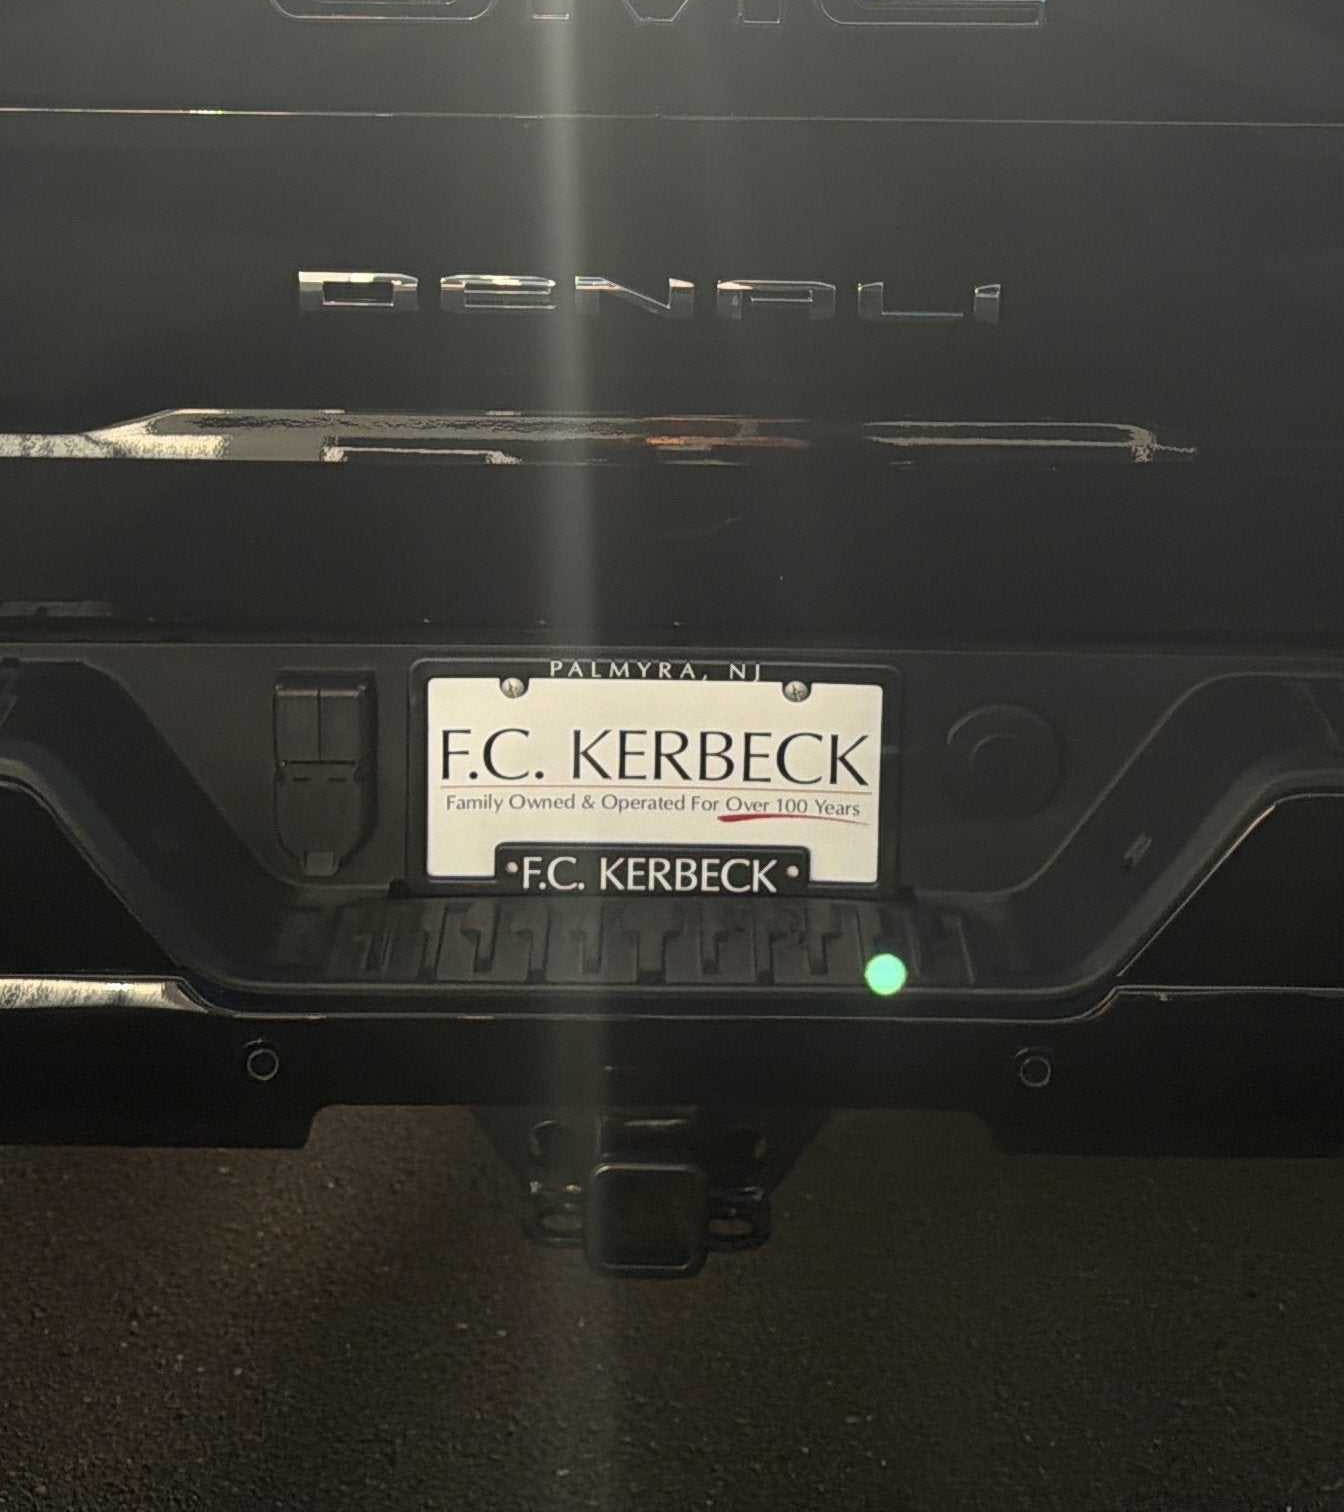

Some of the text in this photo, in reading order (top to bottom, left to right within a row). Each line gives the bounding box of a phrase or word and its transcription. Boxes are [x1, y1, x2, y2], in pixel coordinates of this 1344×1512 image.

[550, 660, 761, 683] PALMYRA, NJ
[441, 727, 870, 787] F.C. KERBECK
[446, 793, 861, 816] Family Owned & Operated For Over 100 Years
[522, 855, 778, 893] F.C. KERBECK
